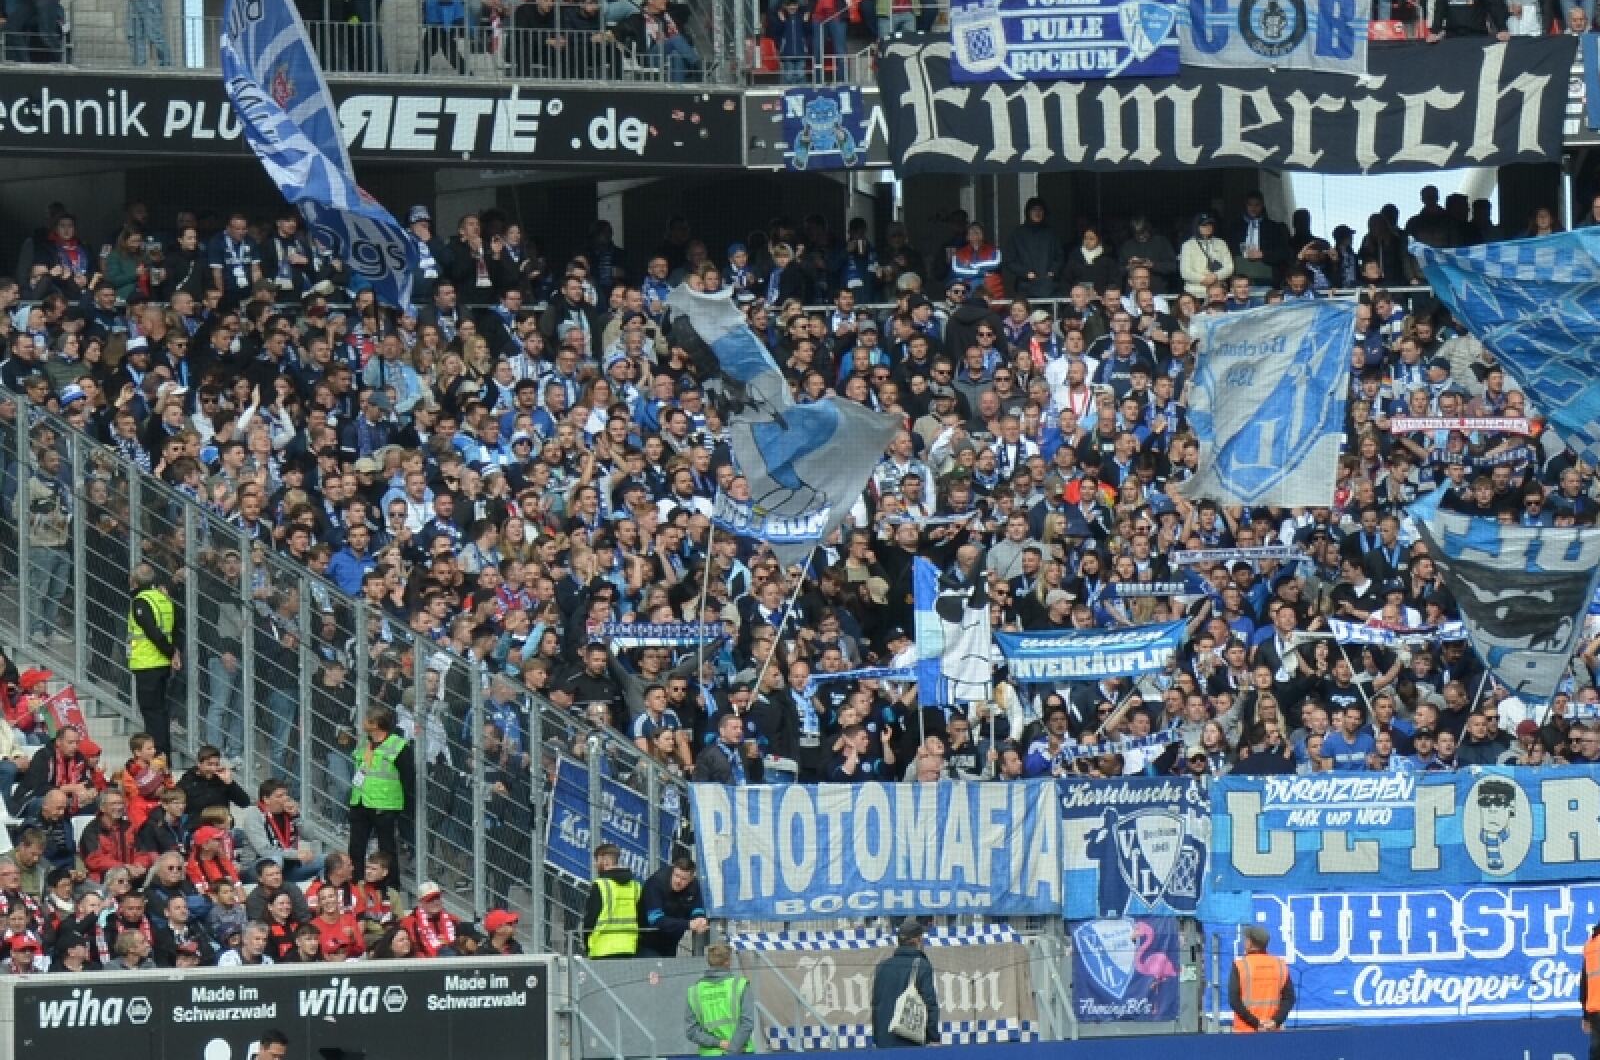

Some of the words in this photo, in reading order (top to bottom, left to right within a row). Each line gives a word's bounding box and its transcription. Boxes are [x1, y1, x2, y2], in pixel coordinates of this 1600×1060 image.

[1022, 17, 1104, 40] PULLE
[1011, 49, 1118, 73] BOCHUM
[902, 41, 1553, 167] Emmerich
[696, 781, 1059, 907] PHOTOMAFIA
[775, 890, 993, 915] BOCHUM
[191, 988, 234, 1003] Made
[238, 986, 259, 1002] im
[445, 974, 485, 991] Made
[489, 974, 509, 989] im
[39, 988, 123, 1029] wiha
[299, 976, 379, 1018] wiha
[427, 991, 527, 1011] Schwarzwald
[173, 1002, 278, 1023] Schwarzwald
